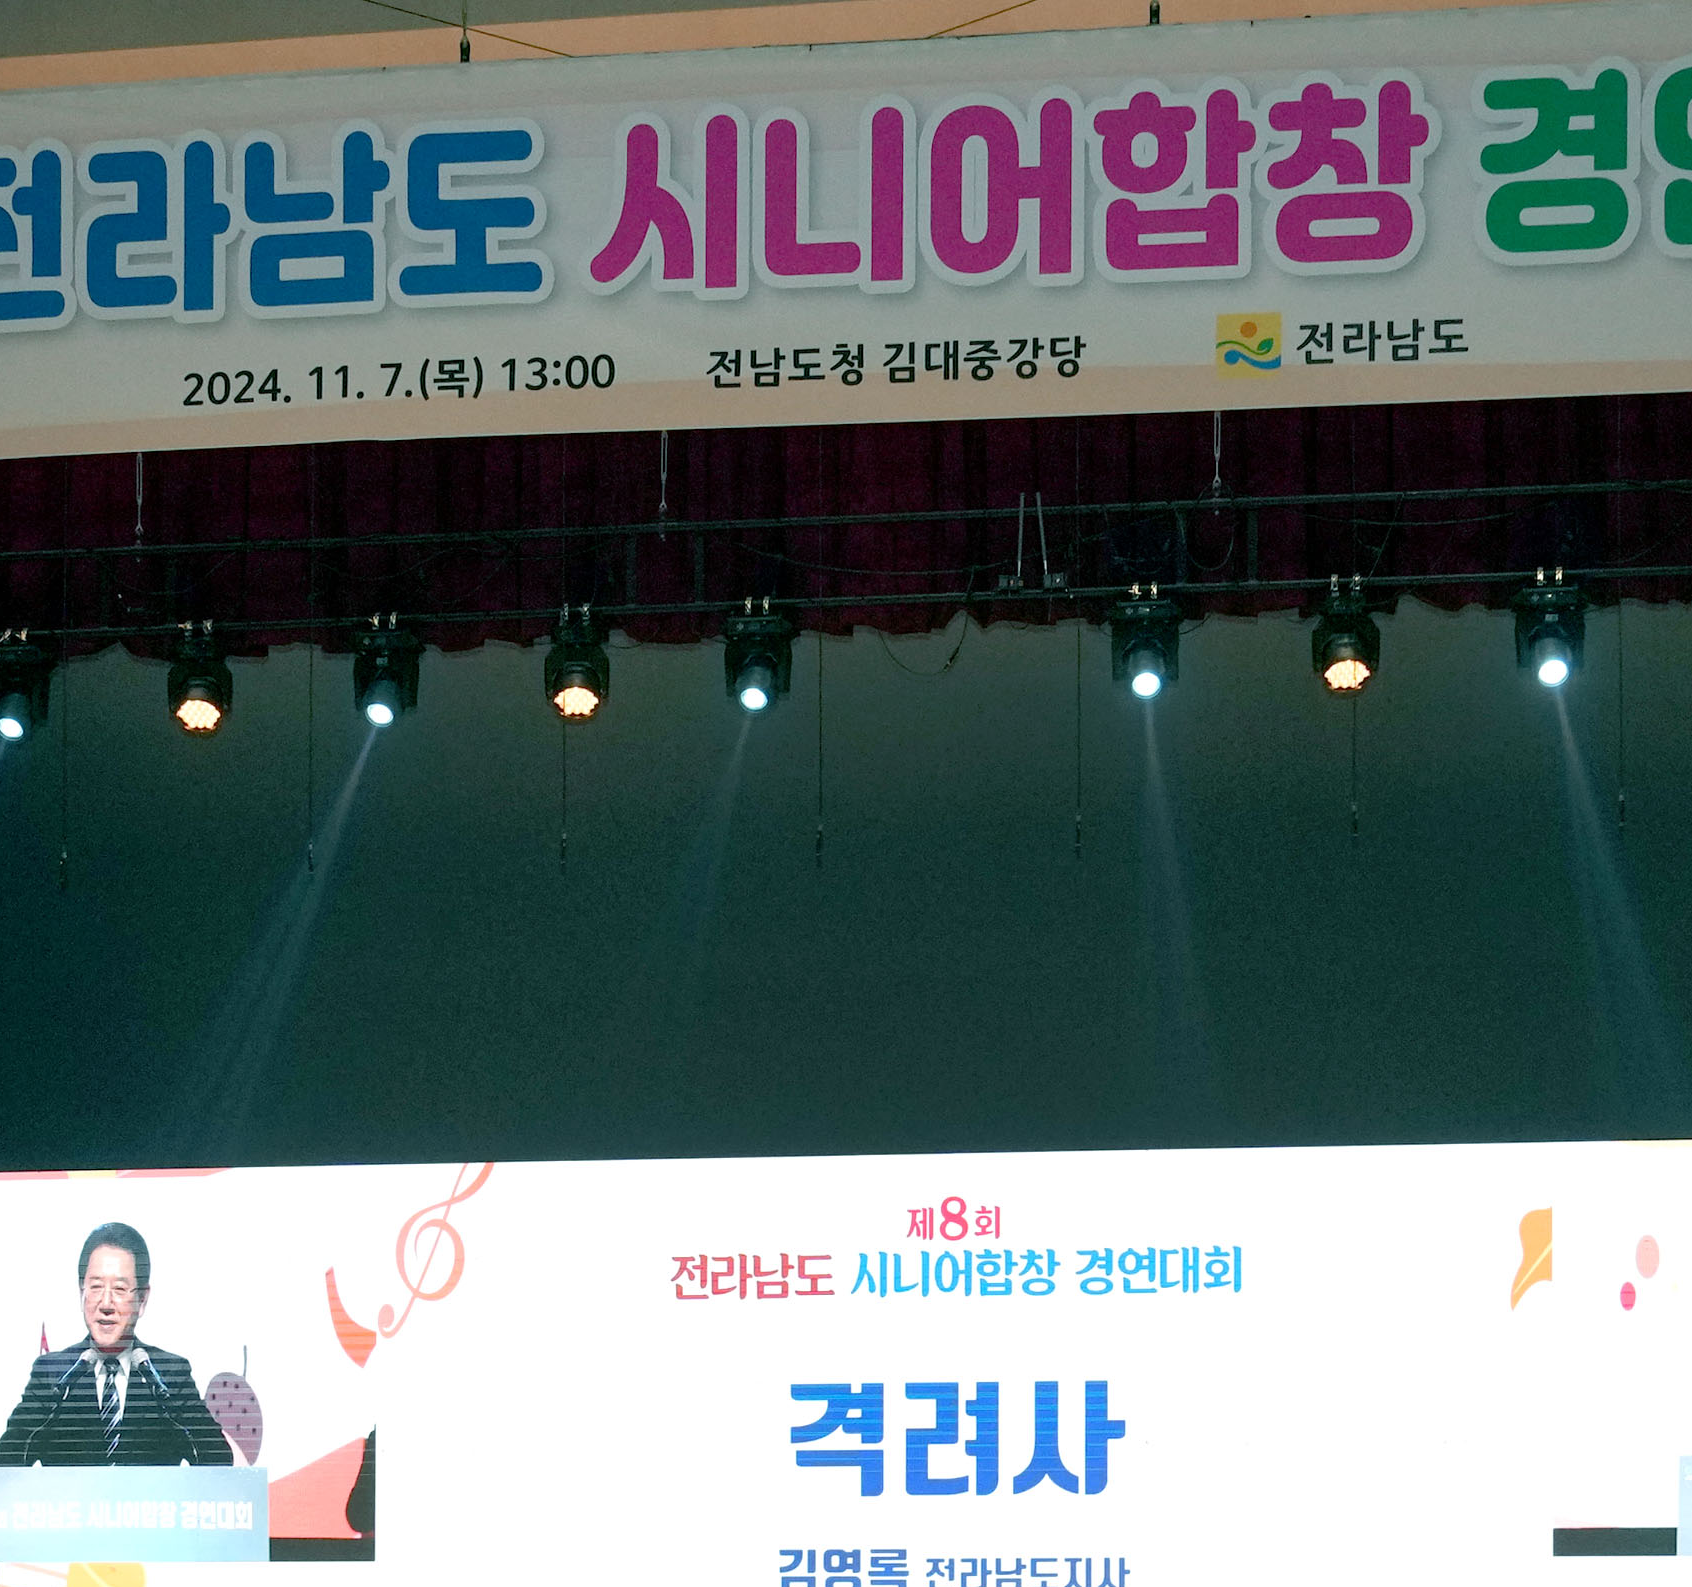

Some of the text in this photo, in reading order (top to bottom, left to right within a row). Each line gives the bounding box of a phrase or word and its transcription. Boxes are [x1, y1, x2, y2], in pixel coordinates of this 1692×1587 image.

[589, 79, 1430, 289] 시니어합창
[706, 334, 1087, 389] 전남도청 김대중강당
[1296, 318, 1470, 365] 전라남도
[183, 354, 616, 406] 2024. 11. 7.(목) 13:00
[907, 1195, 1001, 1241] 제8회
[671, 1244, 1243, 1300] 전라남도 시니어합창 경연대회
[789, 1379, 1127, 1497] 격려사
